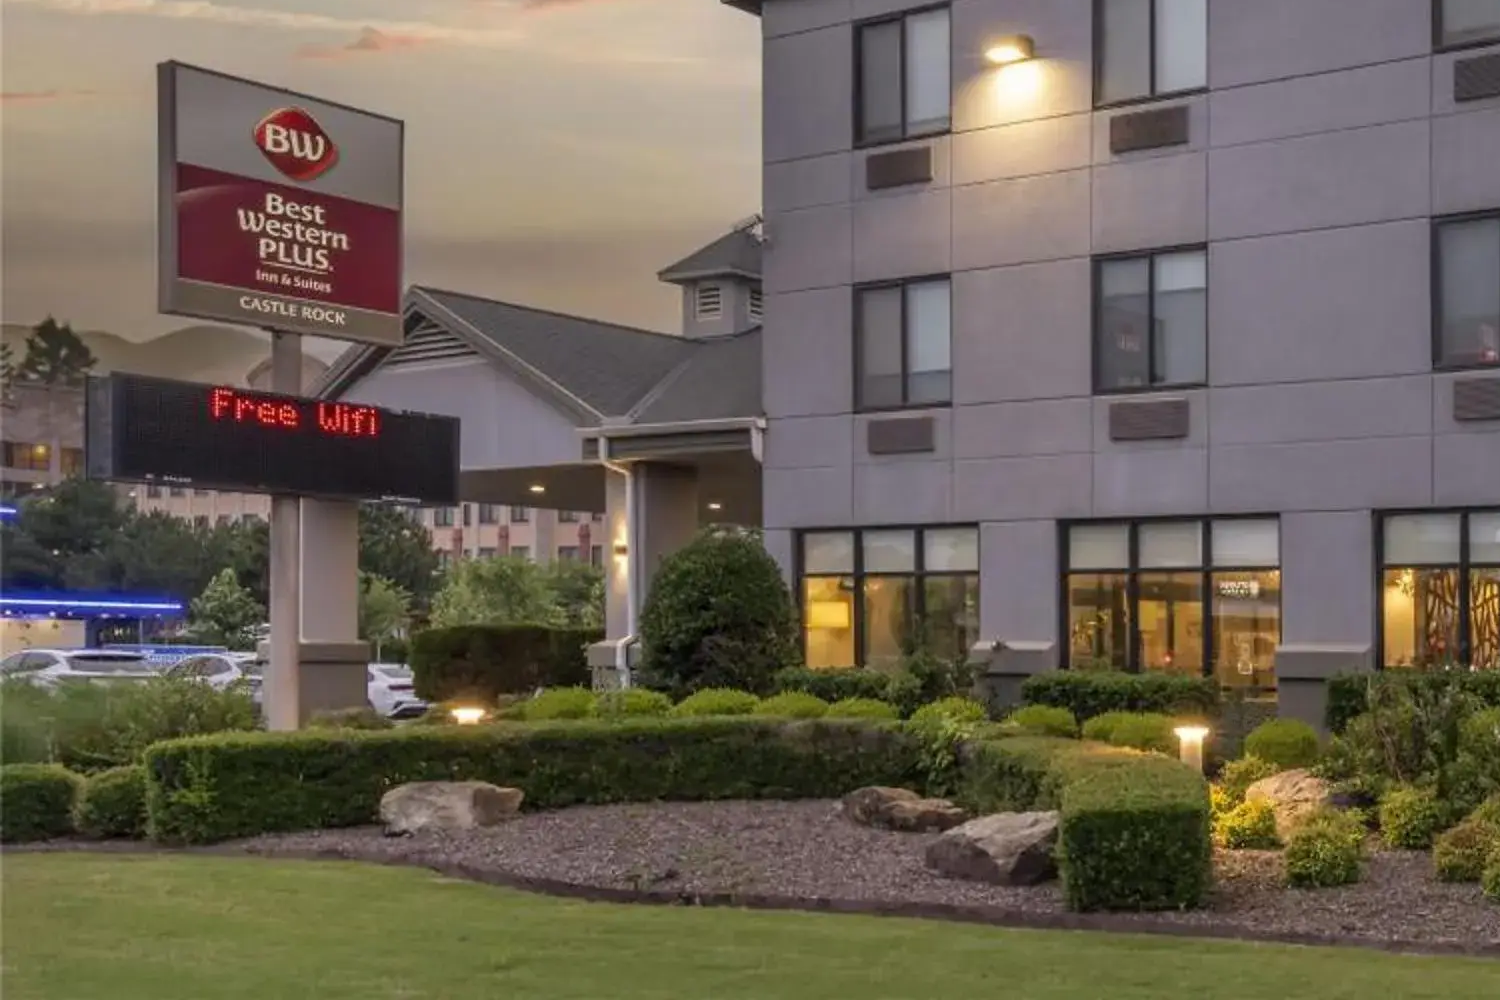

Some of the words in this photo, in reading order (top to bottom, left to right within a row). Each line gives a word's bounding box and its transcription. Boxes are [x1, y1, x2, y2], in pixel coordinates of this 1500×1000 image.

[263, 122, 326, 163] BW
[265, 192, 326, 226] Best
[236, 207, 351, 252] Western
[255, 269, 279, 286] Inn
[281, 273, 292, 287] &
[293, 274, 333, 294] Suites
[239, 295, 298, 318] CASTLE
[301, 304, 347, 326] ROCK
[209, 385, 299, 428] Free
[318, 402, 380, 437] Wifi
